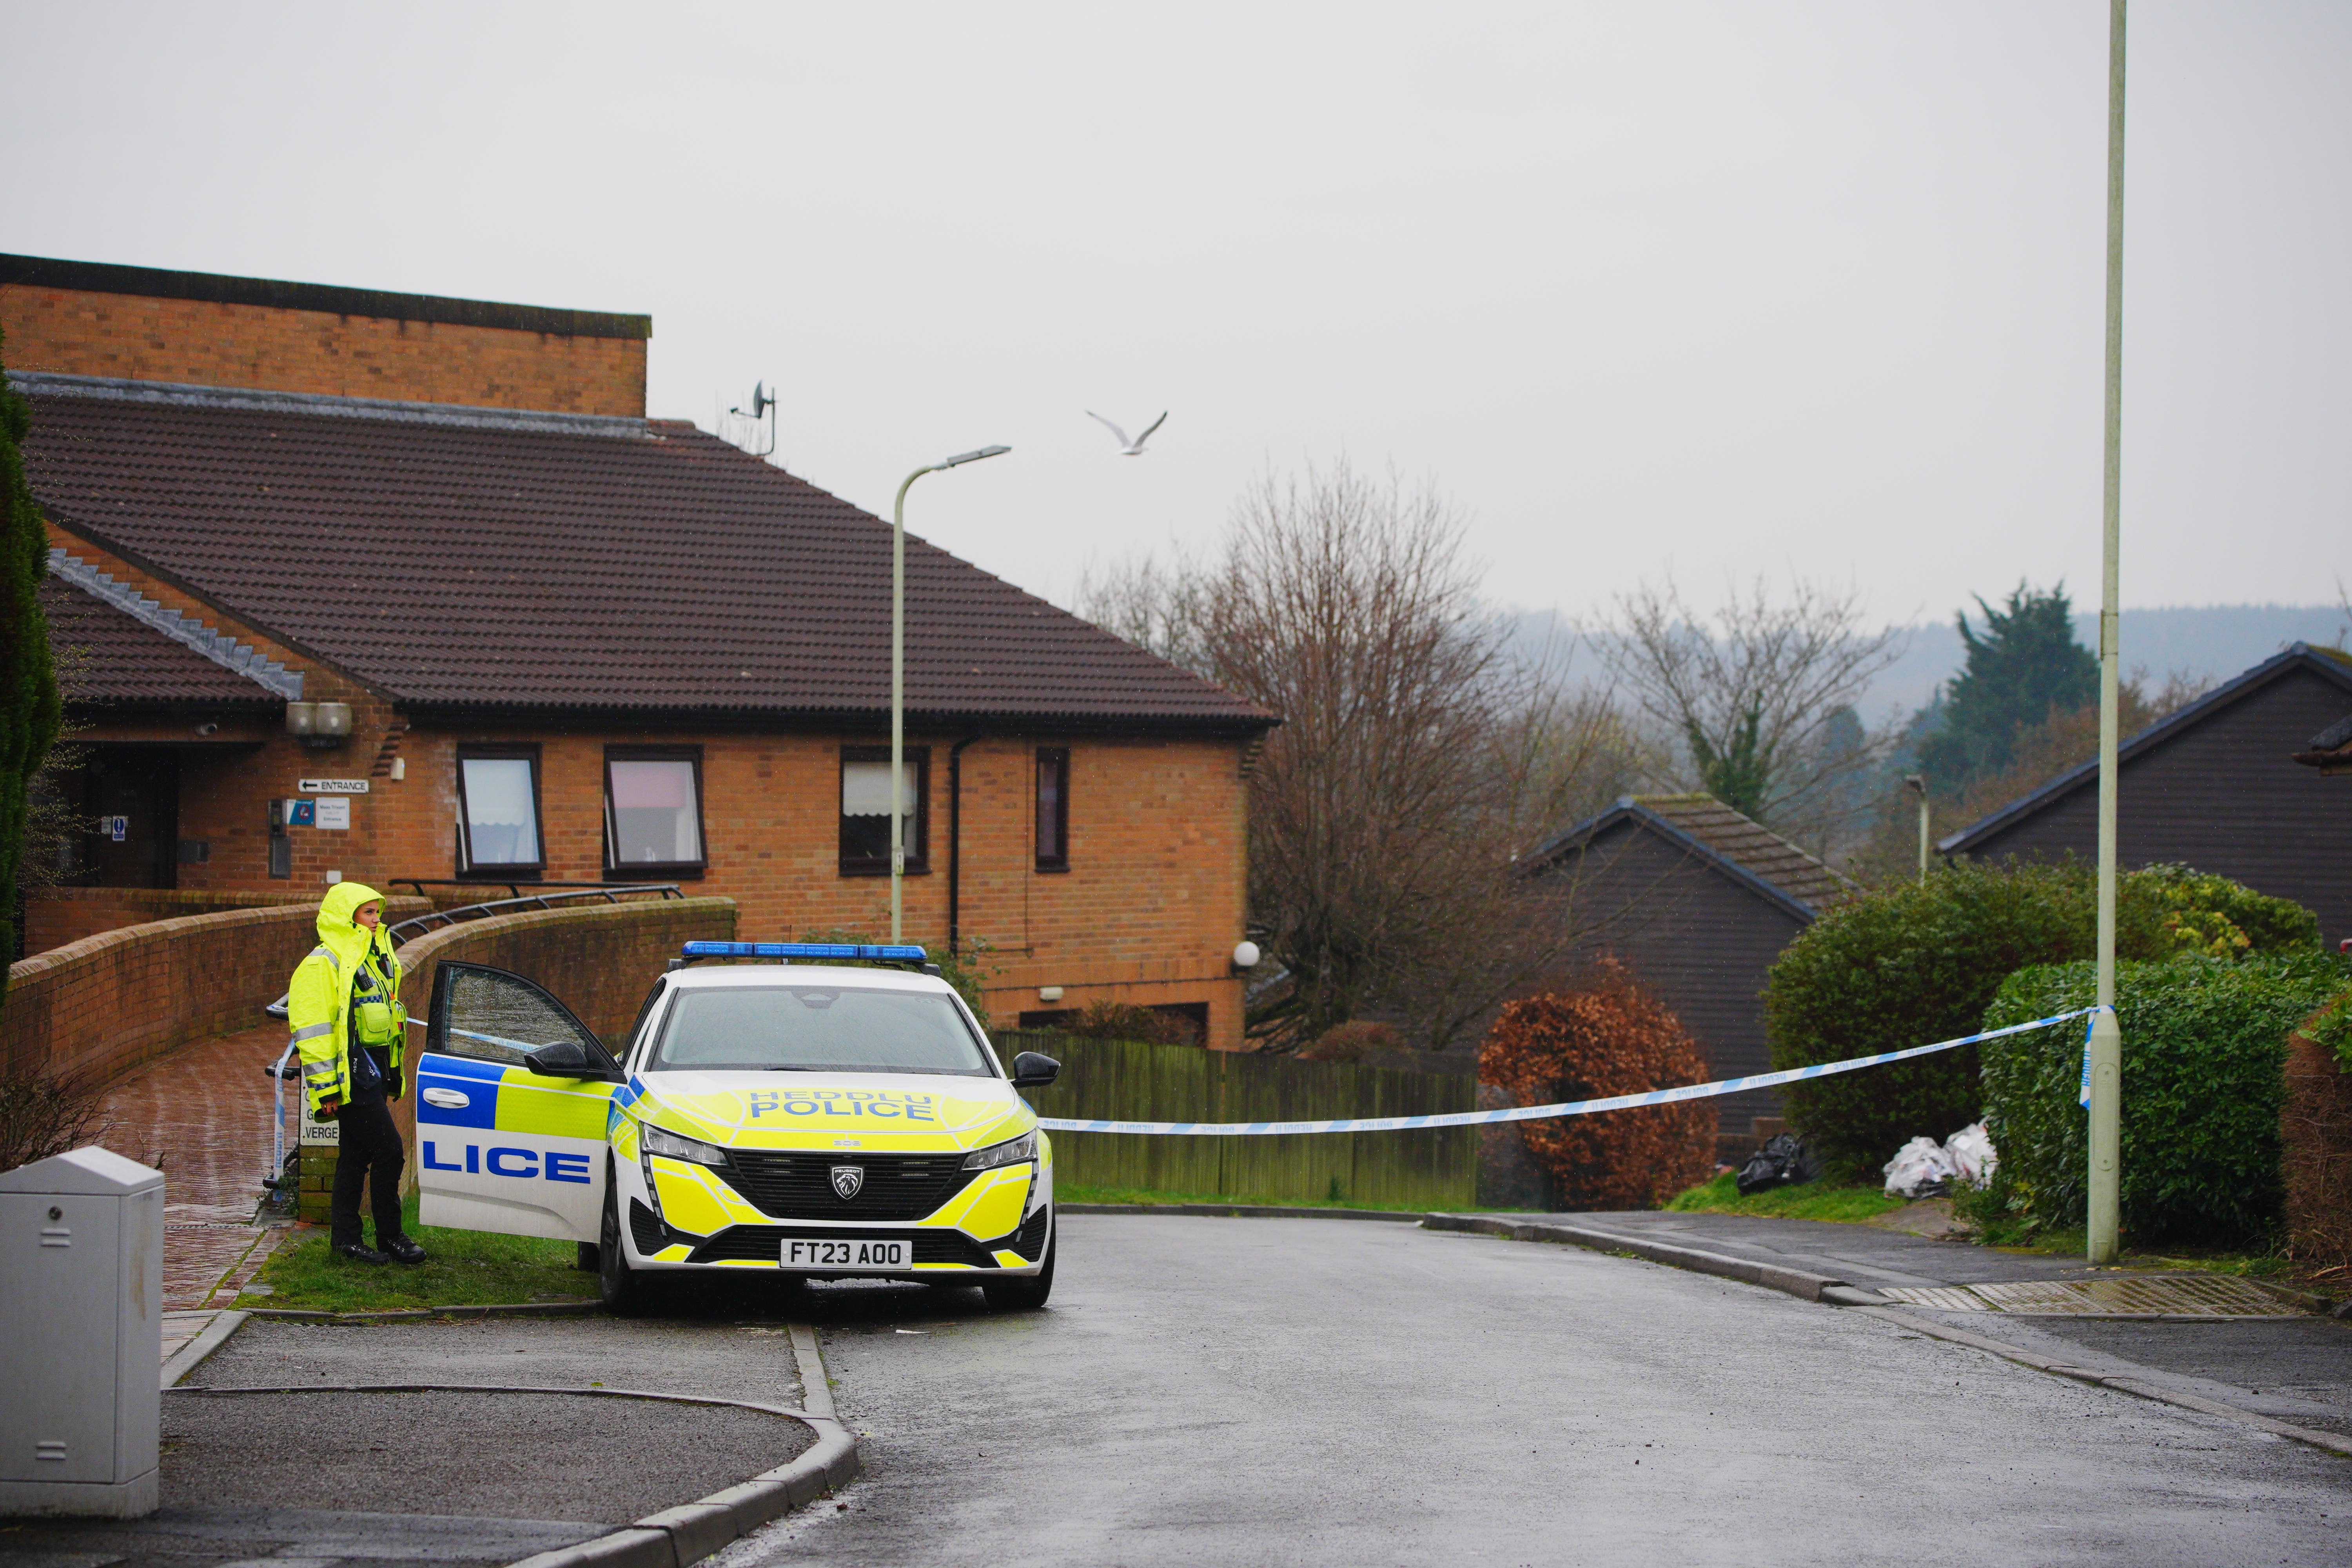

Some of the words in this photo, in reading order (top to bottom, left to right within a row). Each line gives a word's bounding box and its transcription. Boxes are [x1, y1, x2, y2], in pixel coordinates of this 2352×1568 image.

[321, 782, 365, 790] ENTRANCE
[750, 1091, 932, 1104] HEDDLU
[750, 1100, 935, 1122] POLICE
[306, 1127, 338, 1139] VERGE
[791, 1242, 850, 1263] FT23
[858, 1243, 901, 1264] AOO
